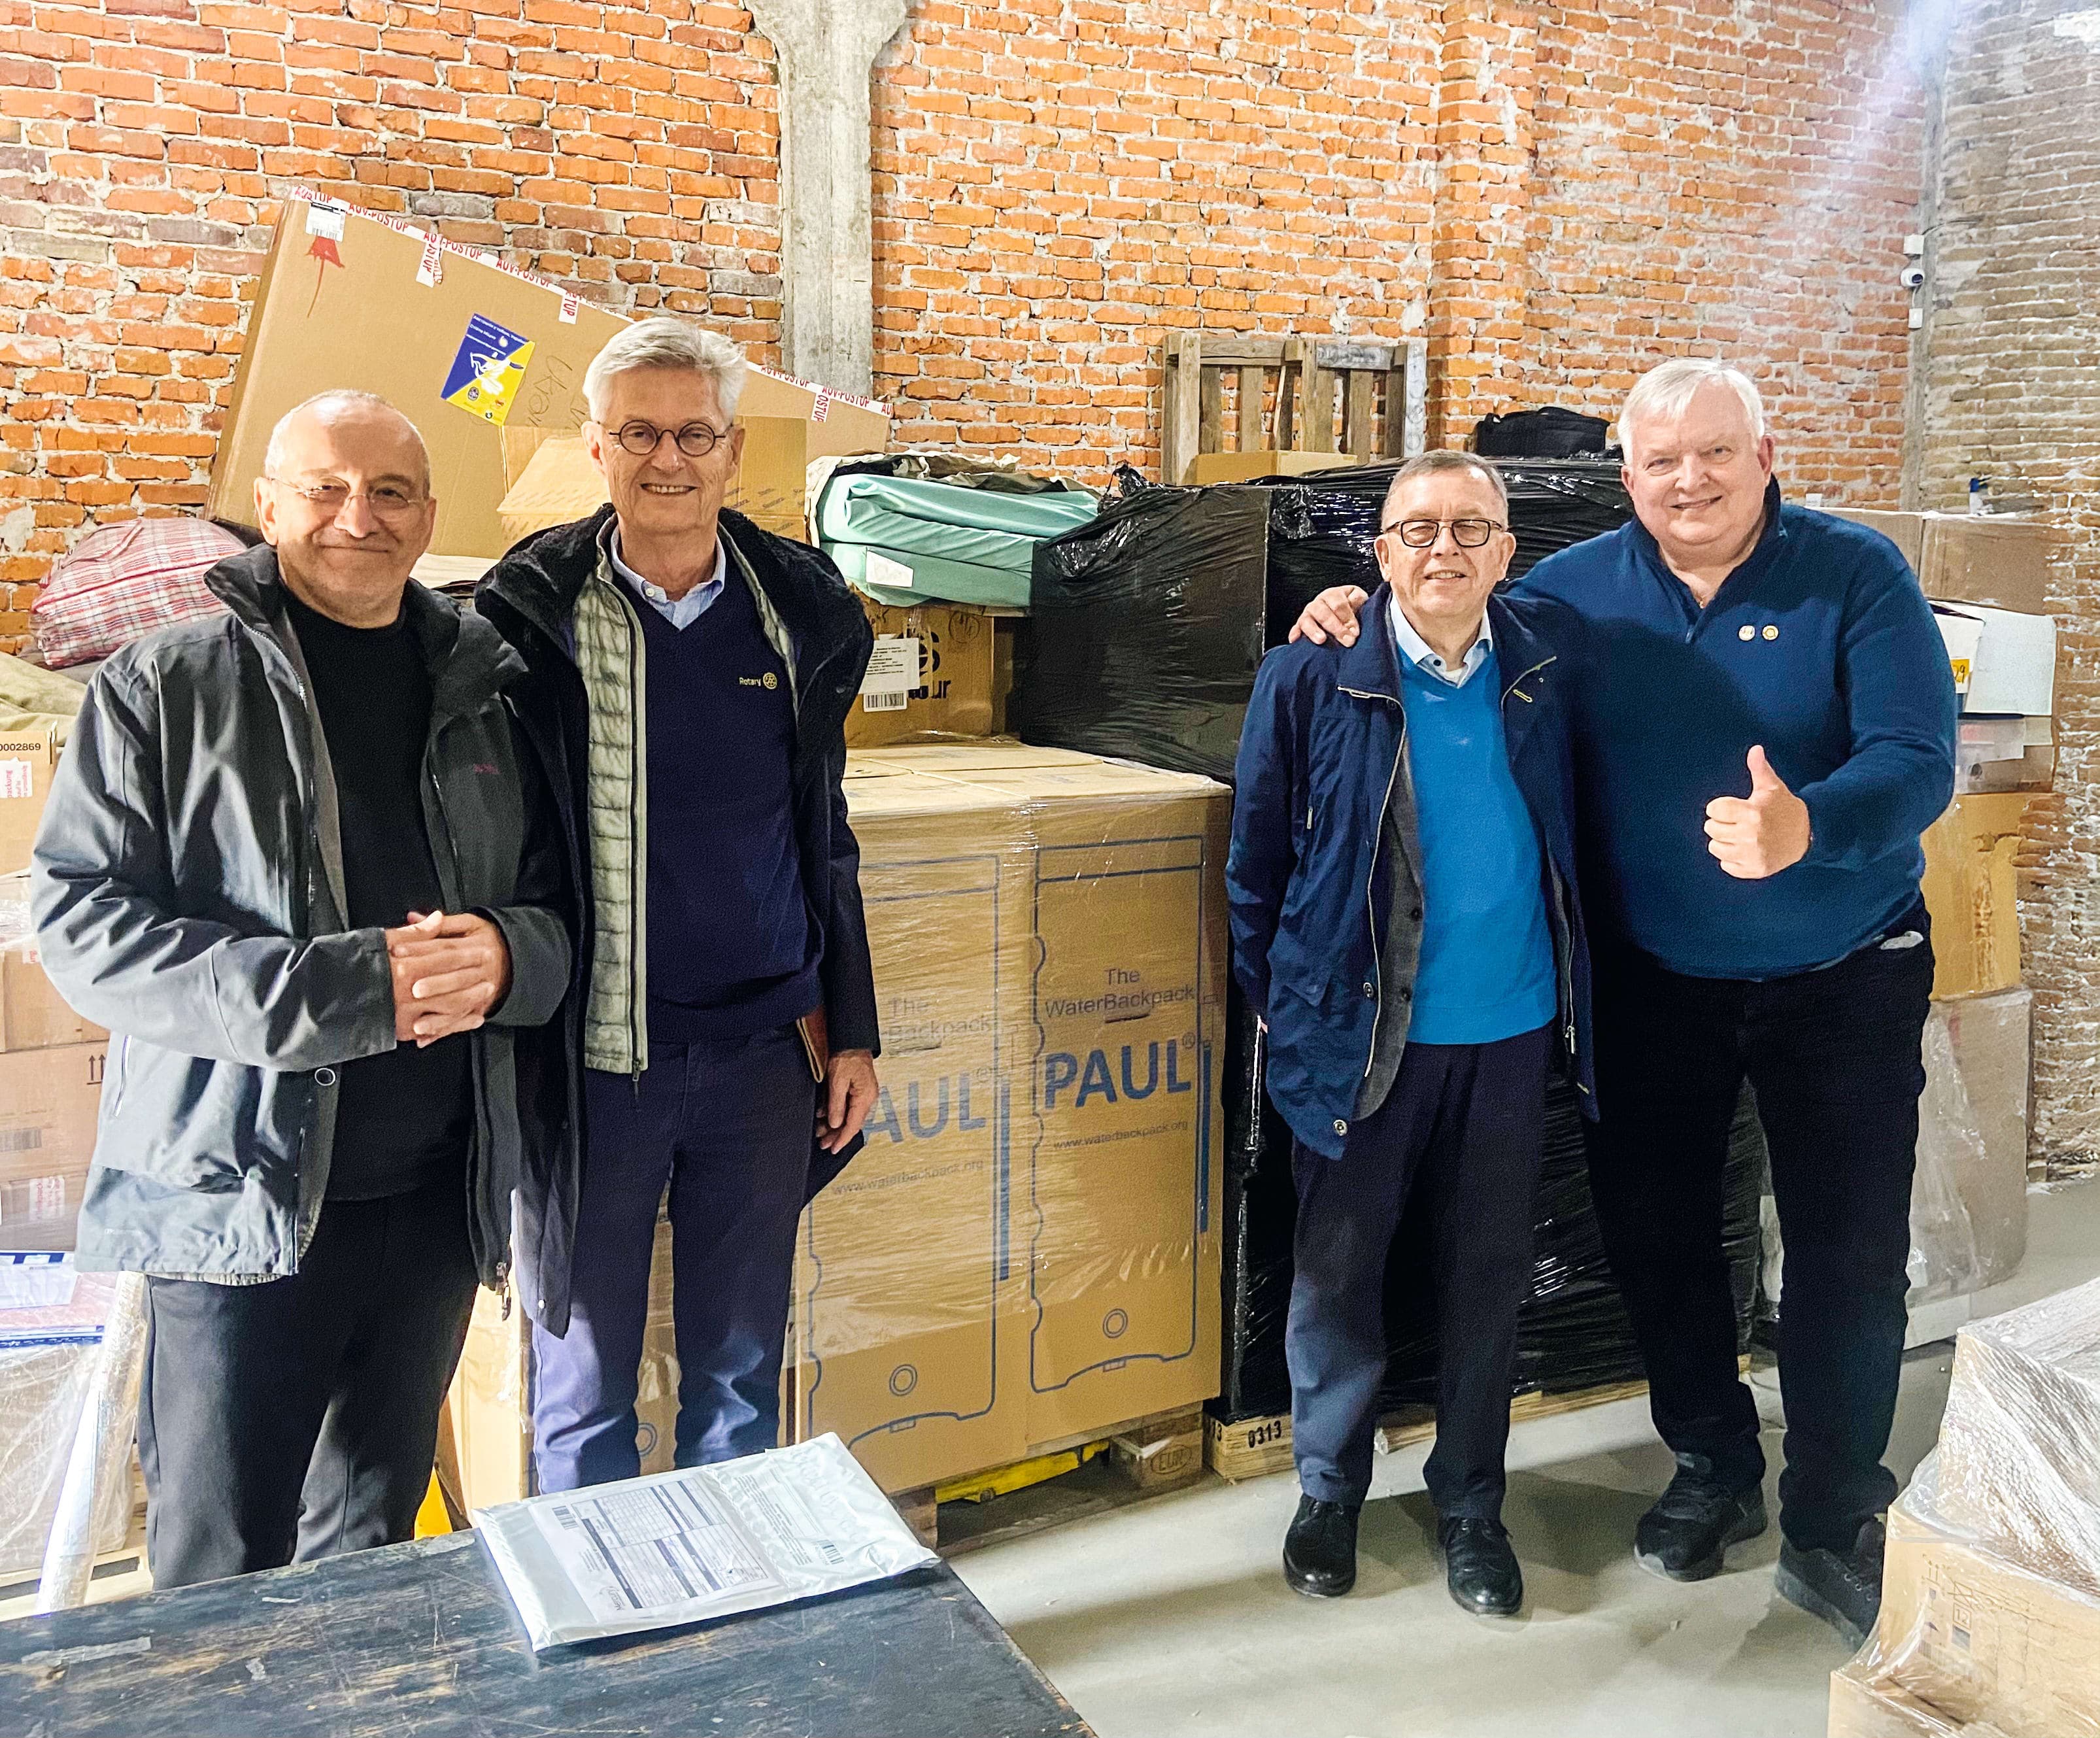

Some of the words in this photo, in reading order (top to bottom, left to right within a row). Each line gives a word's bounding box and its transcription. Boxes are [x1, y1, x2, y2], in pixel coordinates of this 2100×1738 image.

[739, 677, 761, 687] Rotary
[1105, 968, 1140, 985] The
[1045, 984, 1197, 1018] WaterBackpack
[864, 1073, 986, 1144] AUL
[1053, 1119, 1189, 1149] www.waterbackpack.org
[1248, 1420, 1282, 1448] 0313
